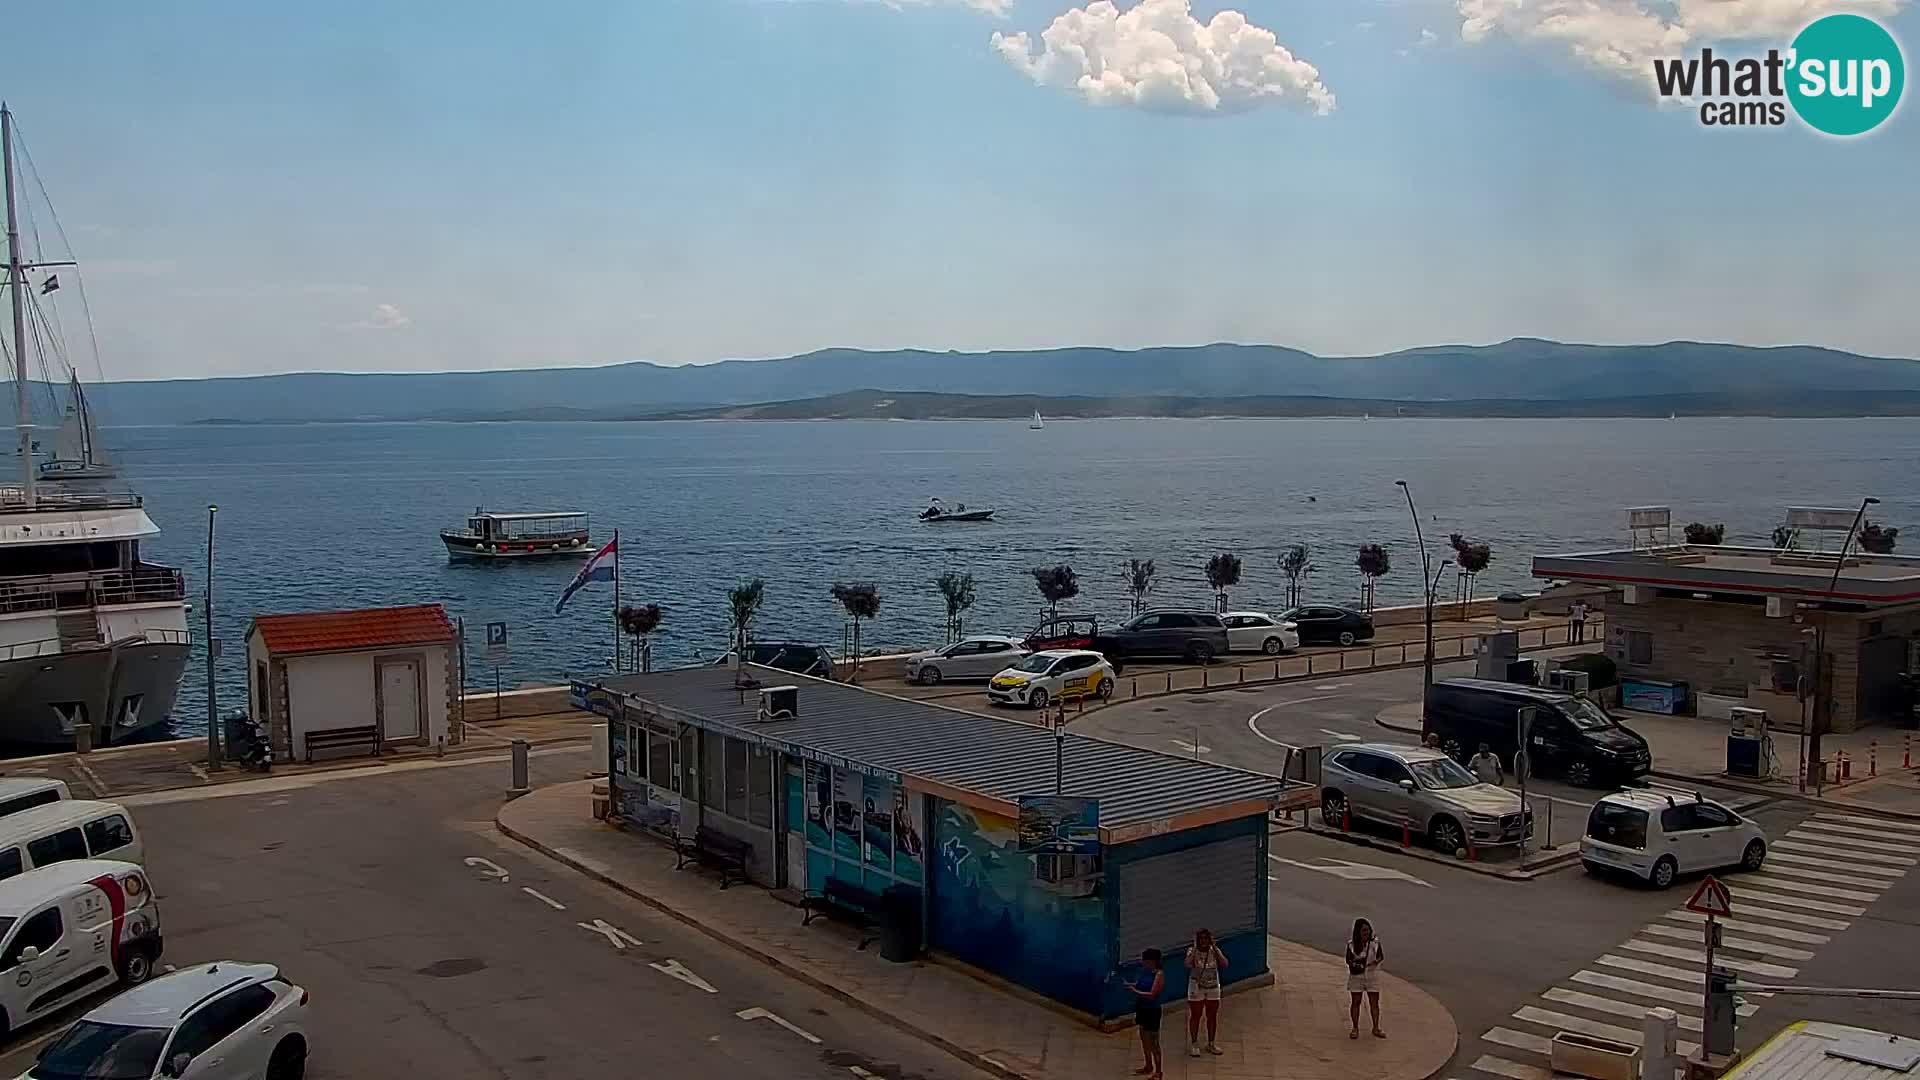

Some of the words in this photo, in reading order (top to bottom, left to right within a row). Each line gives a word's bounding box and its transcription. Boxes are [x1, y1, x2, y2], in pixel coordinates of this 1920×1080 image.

[491, 625, 502, 641] P
[815, 751, 846, 768] STATION
[847, 760, 872, 776] TICKET
